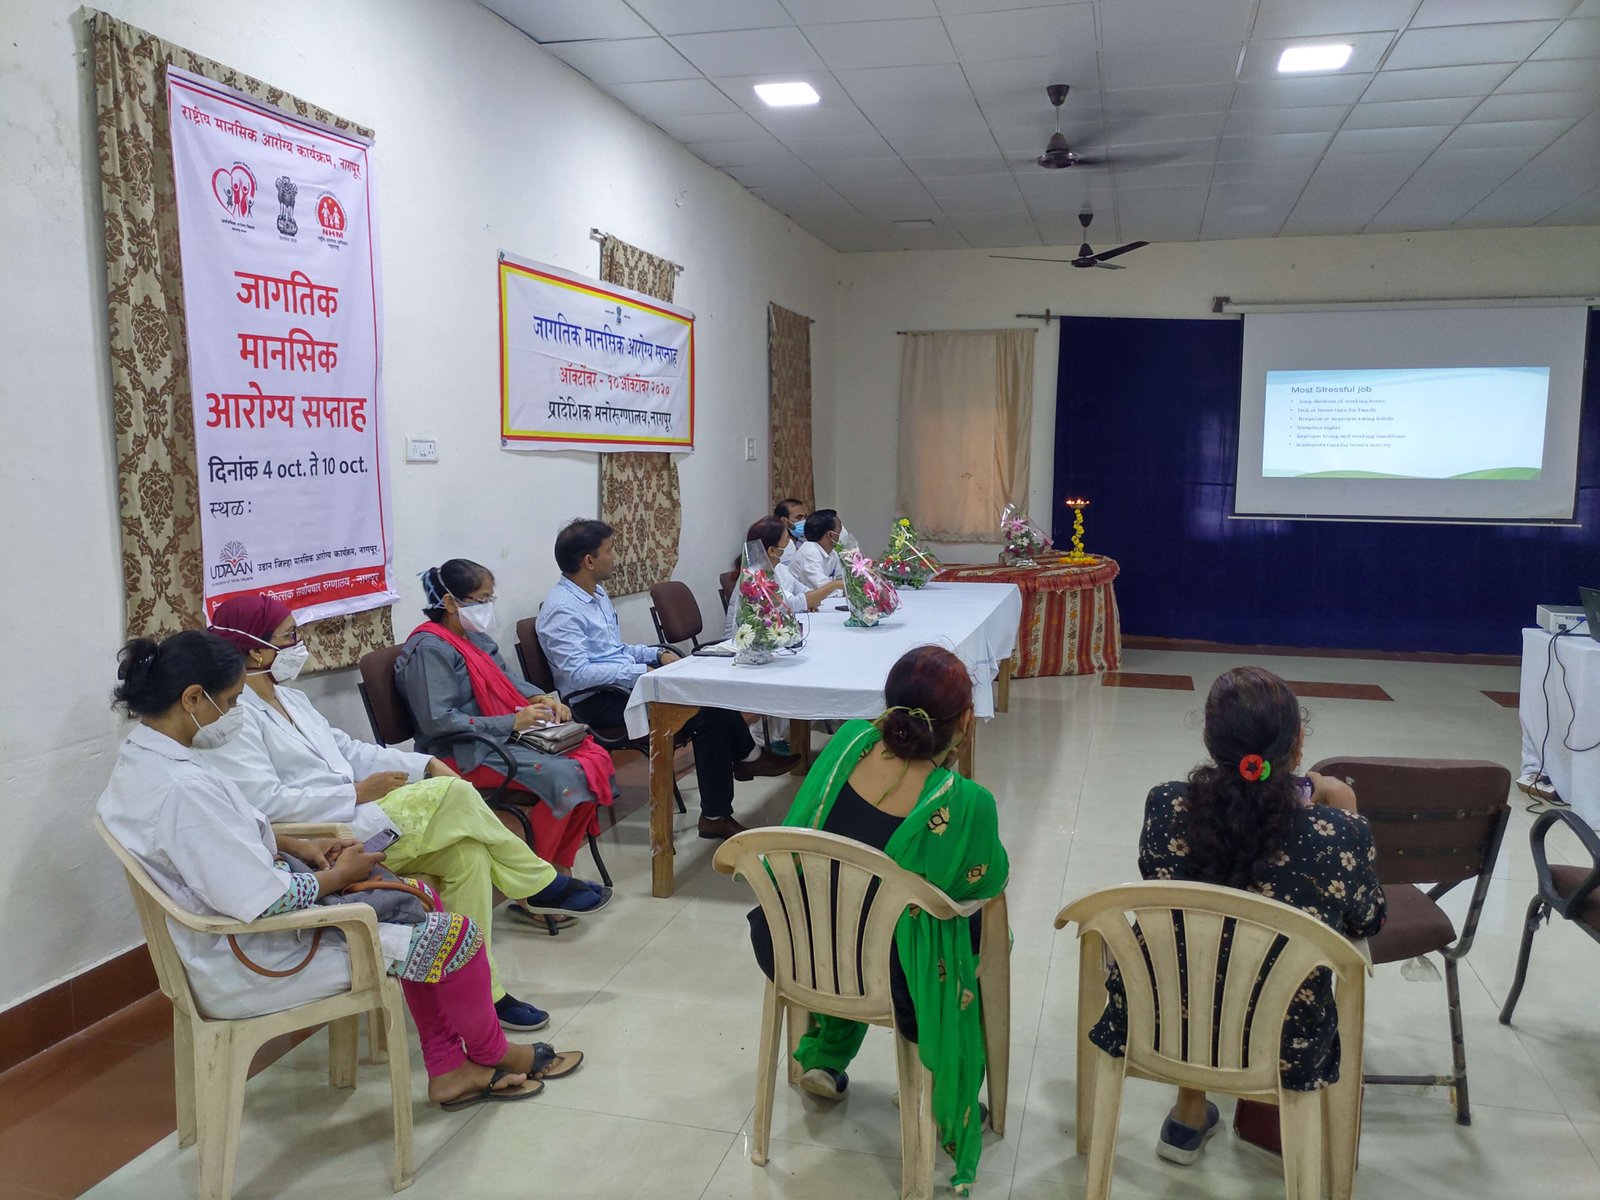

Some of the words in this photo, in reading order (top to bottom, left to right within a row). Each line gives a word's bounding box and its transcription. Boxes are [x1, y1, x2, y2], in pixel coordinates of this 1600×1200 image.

[214, 117, 259, 143] मानसिक
[261, 133, 294, 155] आरोग्य
[338, 157, 362, 181] नागपूर
[321, 227, 345, 240] NHM
[233, 269, 340, 319] जागतिक
[236, 326, 340, 374] मानसिक
[532, 311, 582, 348] जागतिक
[584, 323, 626, 356] मानसिक
[627, 332, 654, 364] आरोग्य
[205, 380, 296, 429] आरोग्य
[300, 395, 368, 433] सप्ताह
[547, 395, 593, 422] प्रादेशिक
[1291, 386, 1313, 394] Most
[208, 455, 259, 484] दिनांक
[262, 460, 273, 480] 4
[277, 459, 307, 479] oct.
[309, 451, 319, 477] ते
[322, 457, 336, 475] 10
[339, 455, 369, 474] oct.
[209, 560, 254, 580] UDAAN
